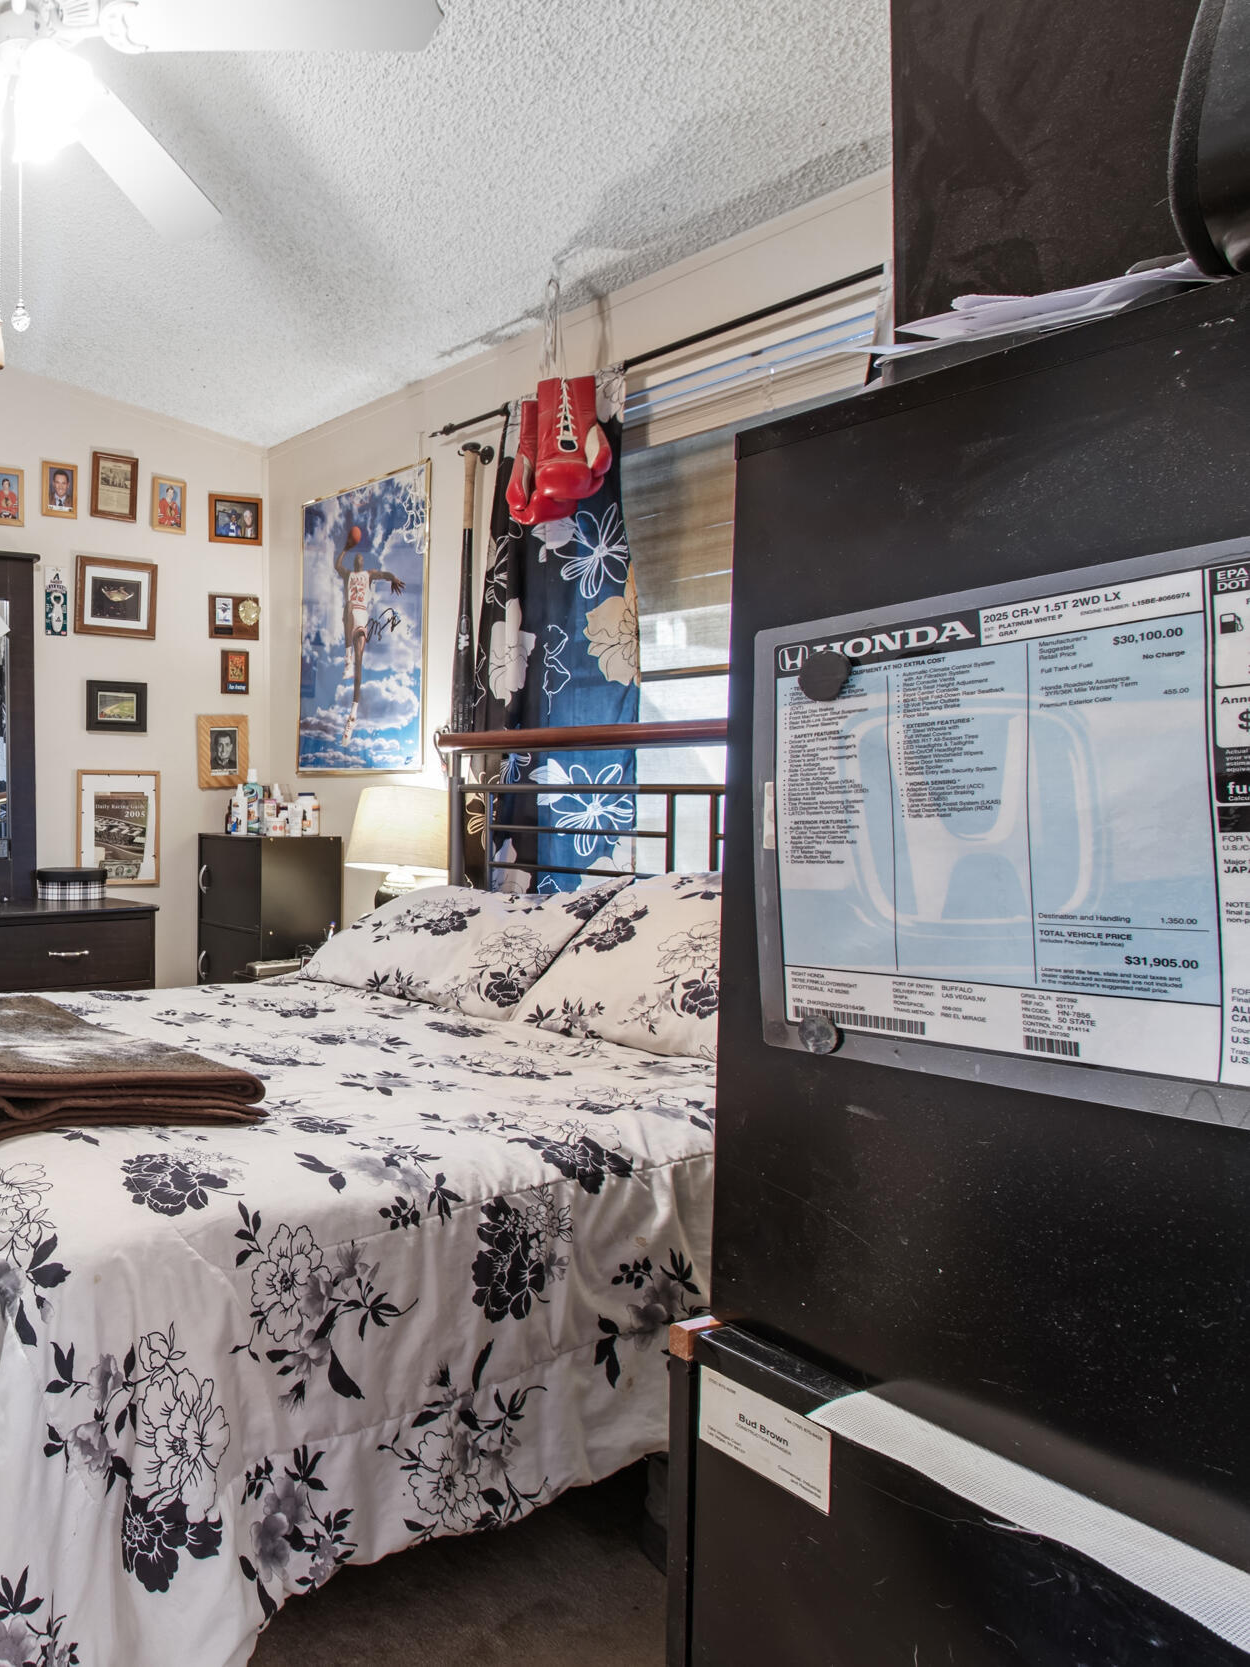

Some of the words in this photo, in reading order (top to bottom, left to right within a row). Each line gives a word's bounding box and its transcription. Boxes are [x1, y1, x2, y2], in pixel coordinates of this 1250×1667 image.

[1216, 568, 1248, 581] EPA
[982, 610, 1008, 624] 2025
[1011, 605, 1039, 619] CR-V
[1044, 600, 1067, 613] 1.5T
[1072, 594, 1099, 608] 2WD
[1104, 590, 1121, 603] LX
[997, 618, 1032, 630] PLATINUM
[1034, 614, 1055, 624] WHITE
[998, 628, 1018, 638] GRAY
[1112, 626, 1183, 646] $30,100.00
[1038, 634, 1087, 648] Manufacturer's
[1038, 643, 1074, 655] Suggested
[1038, 652, 1058, 661] Retail
[1058, 650, 1076, 658] Price
[1142, 652, 1153, 661] No
[1155, 648, 1185, 660] Charge
[903, 659, 926, 668] EXTRA
[926, 656, 946, 664] COST
[1040, 666, 1051, 674] Full
[1054, 664, 1069, 672] Tank
[1078, 661, 1093, 669] Fuel
[1162, 686, 1189, 696] 455.00
[1038, 700, 1064, 709] Premium
[1069, 697, 1092, 706] Exterior
[1094, 695, 1112, 703] Color
[1037, 912, 1077, 920] Destination
[1095, 915, 1130, 923] Handling
[1160, 917, 1197, 925] 1,350.00
[1039, 929, 1066, 937] TOTAL
[1066, 931, 1103, 939] VEHICLE
[1123, 955, 1198, 970] $31,905.00
[940, 984, 973, 993] BUFFALO
[738, 1413, 757, 1429] Bud
[759, 1423, 789, 1447] Brown
